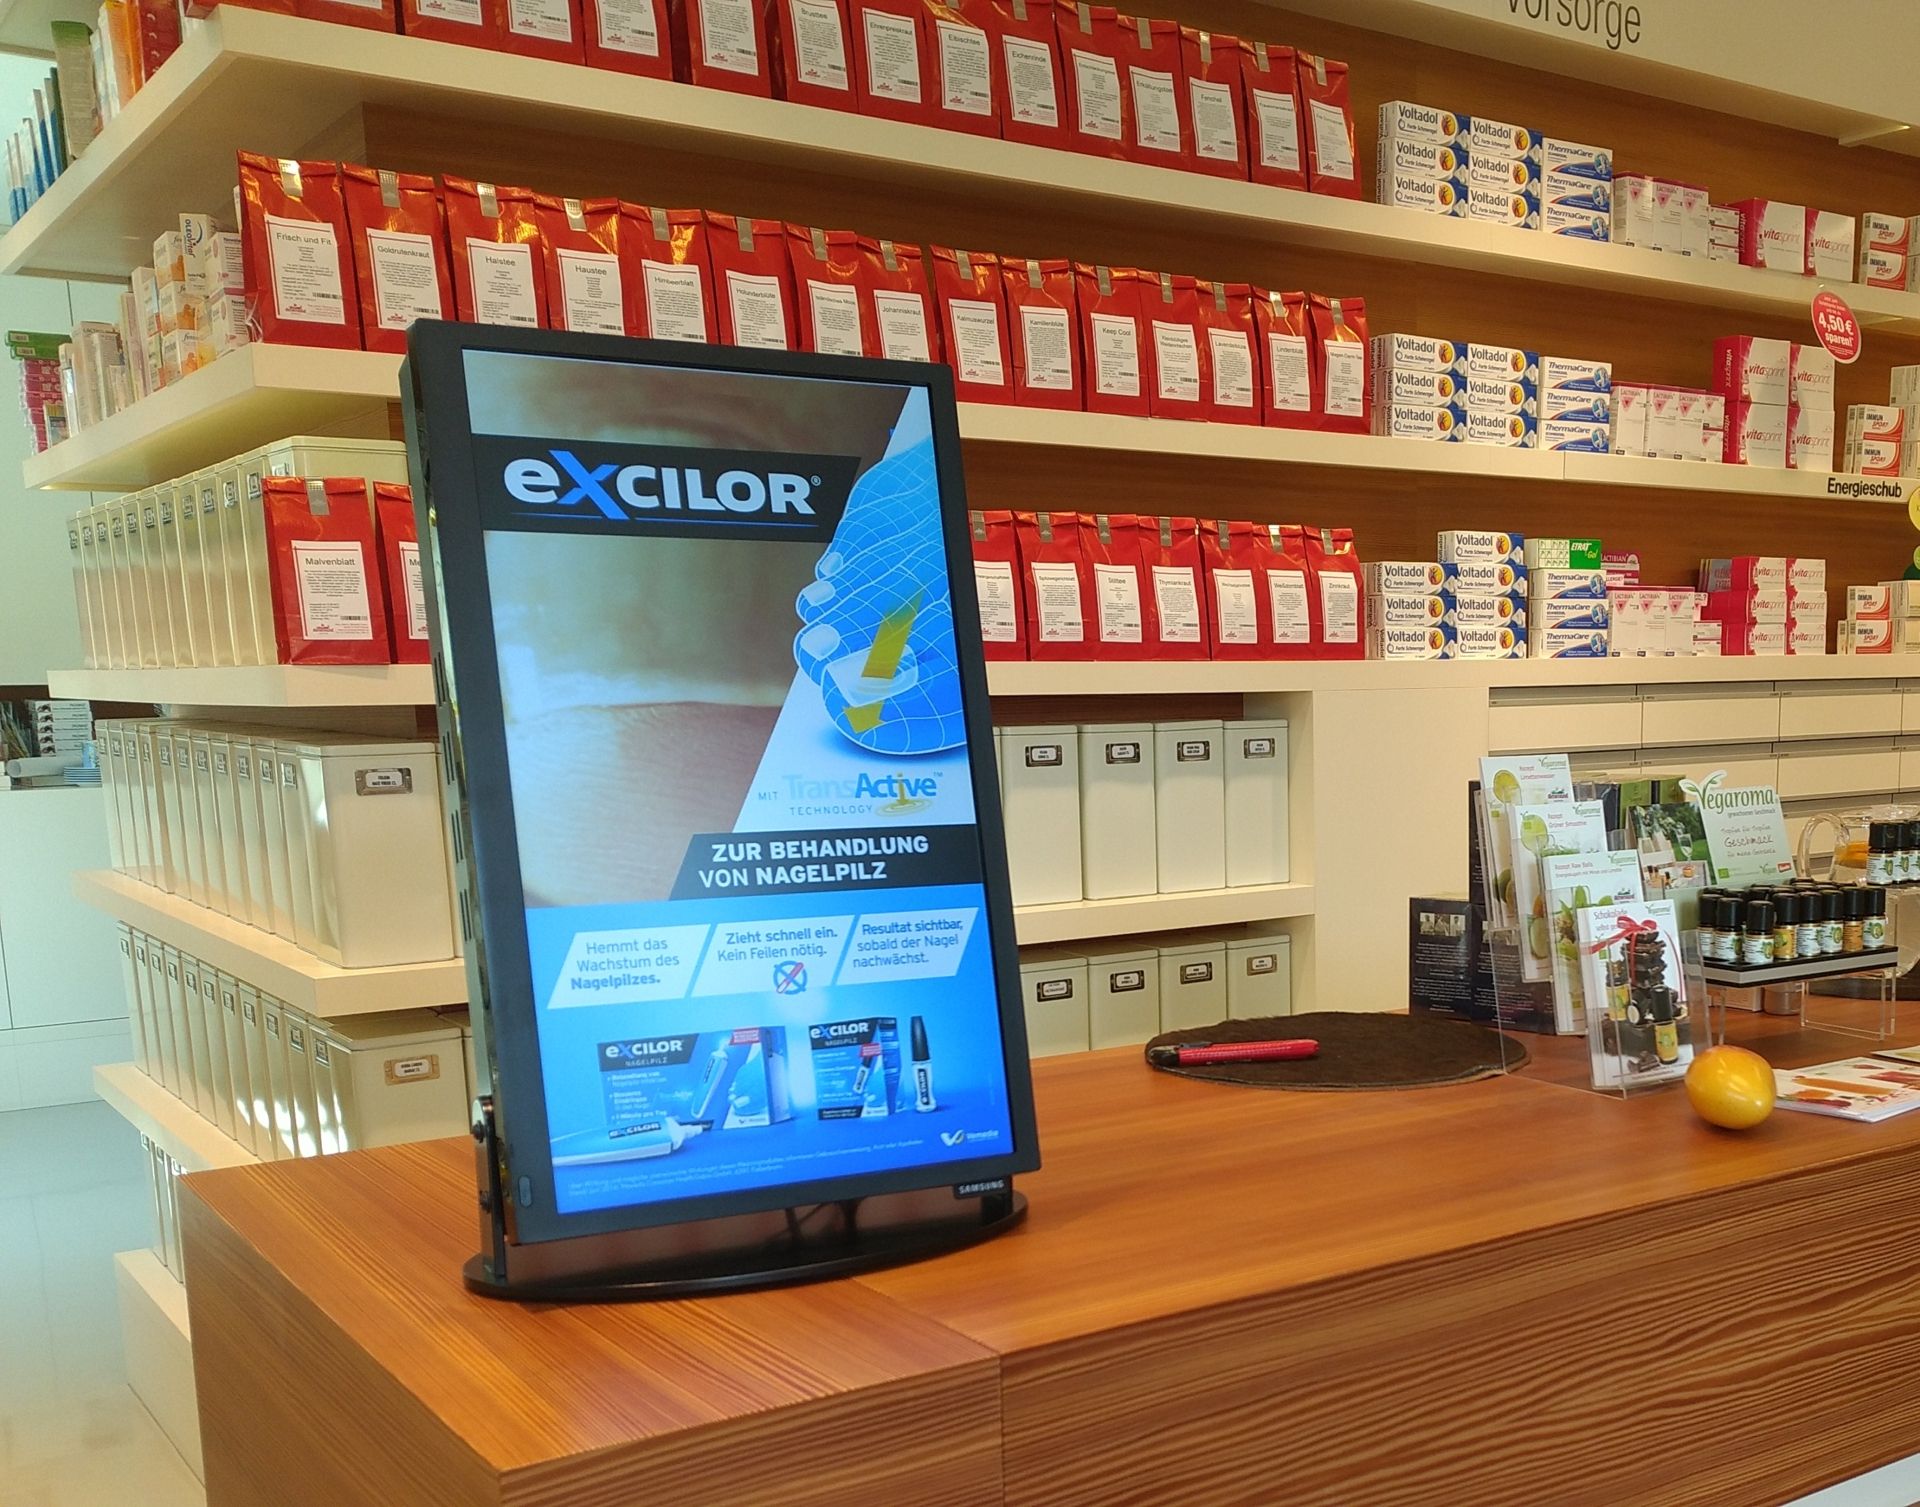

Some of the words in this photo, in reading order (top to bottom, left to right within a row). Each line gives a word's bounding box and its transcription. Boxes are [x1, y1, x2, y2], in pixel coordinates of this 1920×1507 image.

[1509, 0, 1641, 51] orsorge
[1398, 105, 1438, 125] Voltadol
[1473, 120, 1512, 140] Voltadol
[1397, 141, 1437, 160] Voltadol
[1548, 142, 1594, 158] ThermaCare
[1471, 155, 1509, 174] Voltadol
[1395, 176, 1435, 195] Voltadol
[1546, 174, 1592, 190] ThermaCare
[1470, 190, 1509, 207] Voltadol
[1546, 207, 1591, 221] ThermaCare
[276, 233, 301, 243] Frisch
[304, 236, 319, 244] und
[321, 237, 332, 245] Fit
[1764, 229, 1801, 245] vitasprint
[1878, 230, 1895, 238] SPORT
[377, 245, 430, 258] Goldrutenkraut
[1815, 238, 1850, 254] vitasprint
[485, 256, 516, 266] Halstee
[575, 264, 607, 275] Haustee
[1876, 266, 1892, 274] SPORT
[654, 276, 694, 287] Himbeerblatt
[882, 306, 921, 316] Johanniskraut
[957, 314, 995, 325] Kalmuswurzel
[1819, 312, 1845, 333] 4,50
[1845, 320, 1854, 335] €
[1102, 327, 1117, 336] Keep
[1118, 328, 1131, 336] Cool
[1395, 336, 1436, 354] Voltadol
[1470, 347, 1508, 363] Voltadol
[1548, 362, 1594, 373] ThermaCare
[1750, 363, 1786, 378] vitasprint
[1395, 372, 1435, 390] Voltadol
[1798, 371, 1830, 385] vitasprint
[1469, 380, 1507, 397] Voltadol
[1546, 393, 1592, 404] ThermaCare
[1394, 407, 1434, 423] Voltadol
[1469, 414, 1507, 429] Voltadol
[1545, 424, 1590, 435] ThermaCare
[1872, 420, 1888, 428] SPORT
[1746, 428, 1782, 443] vitasprint
[1796, 434, 1830, 448] vitasprint
[1828, 478, 1902, 498] Energieschub
[1456, 534, 1493, 546] Voltadol
[1570, 542, 1591, 551] ETRAT
[305, 557, 356, 566] Malvenblatt
[1384, 565, 1425, 578] Voltadol
[1456, 566, 1495, 578] Voltadol
[1548, 573, 1589, 581] ThermaCare
[1386, 598, 1425, 610] Voltadol
[1458, 598, 1495, 610] Voltadol
[1546, 603, 1590, 611] ThermaCare
[1864, 600, 1878, 608] SPORT
[1387, 630, 1425, 642] Voltadol
[1460, 630, 1496, 642] Voltadol
[1546, 633, 1589, 641] ThermaCare
[758, 791, 778, 801] MIT
[1681, 773, 1774, 814] Vegaroma
[790, 804, 873, 816] TECHNOLOGY
[712, 842, 762, 863] ZUR
[770, 836, 929, 860] BEHANDLUNG
[699, 869, 748, 888] VON
[756, 862, 887, 886] NAGELPILZ
[1594, 909, 1628, 920] Schokolade
[862, 920, 912, 935] Resultat
[915, 918, 963, 933] sichtbar,
[726, 929, 762, 945] Zieht
[766, 927, 811, 942] schnell
[815, 926, 838, 940] ein.
[586, 940, 640, 955] Hemmt
[644, 937, 668, 952] das
[857, 937, 899, 952] sobald
[901, 936, 921, 950] der
[924, 934, 959, 950] Nagel
[717, 946, 747, 962] Kein
[750, 945, 788, 960] Feilen
[790, 942, 828, 959] nötig.
[576, 956, 652, 973] Wachstum
[656, 953, 680, 968] des
[853, 952, 929, 968] nachwächst.
[570, 972, 661, 991] Nagelpilzes.
[625, 1057, 668, 1067] NAGELPILZ
[958, 1179, 1004, 1194] SAMSUNG
